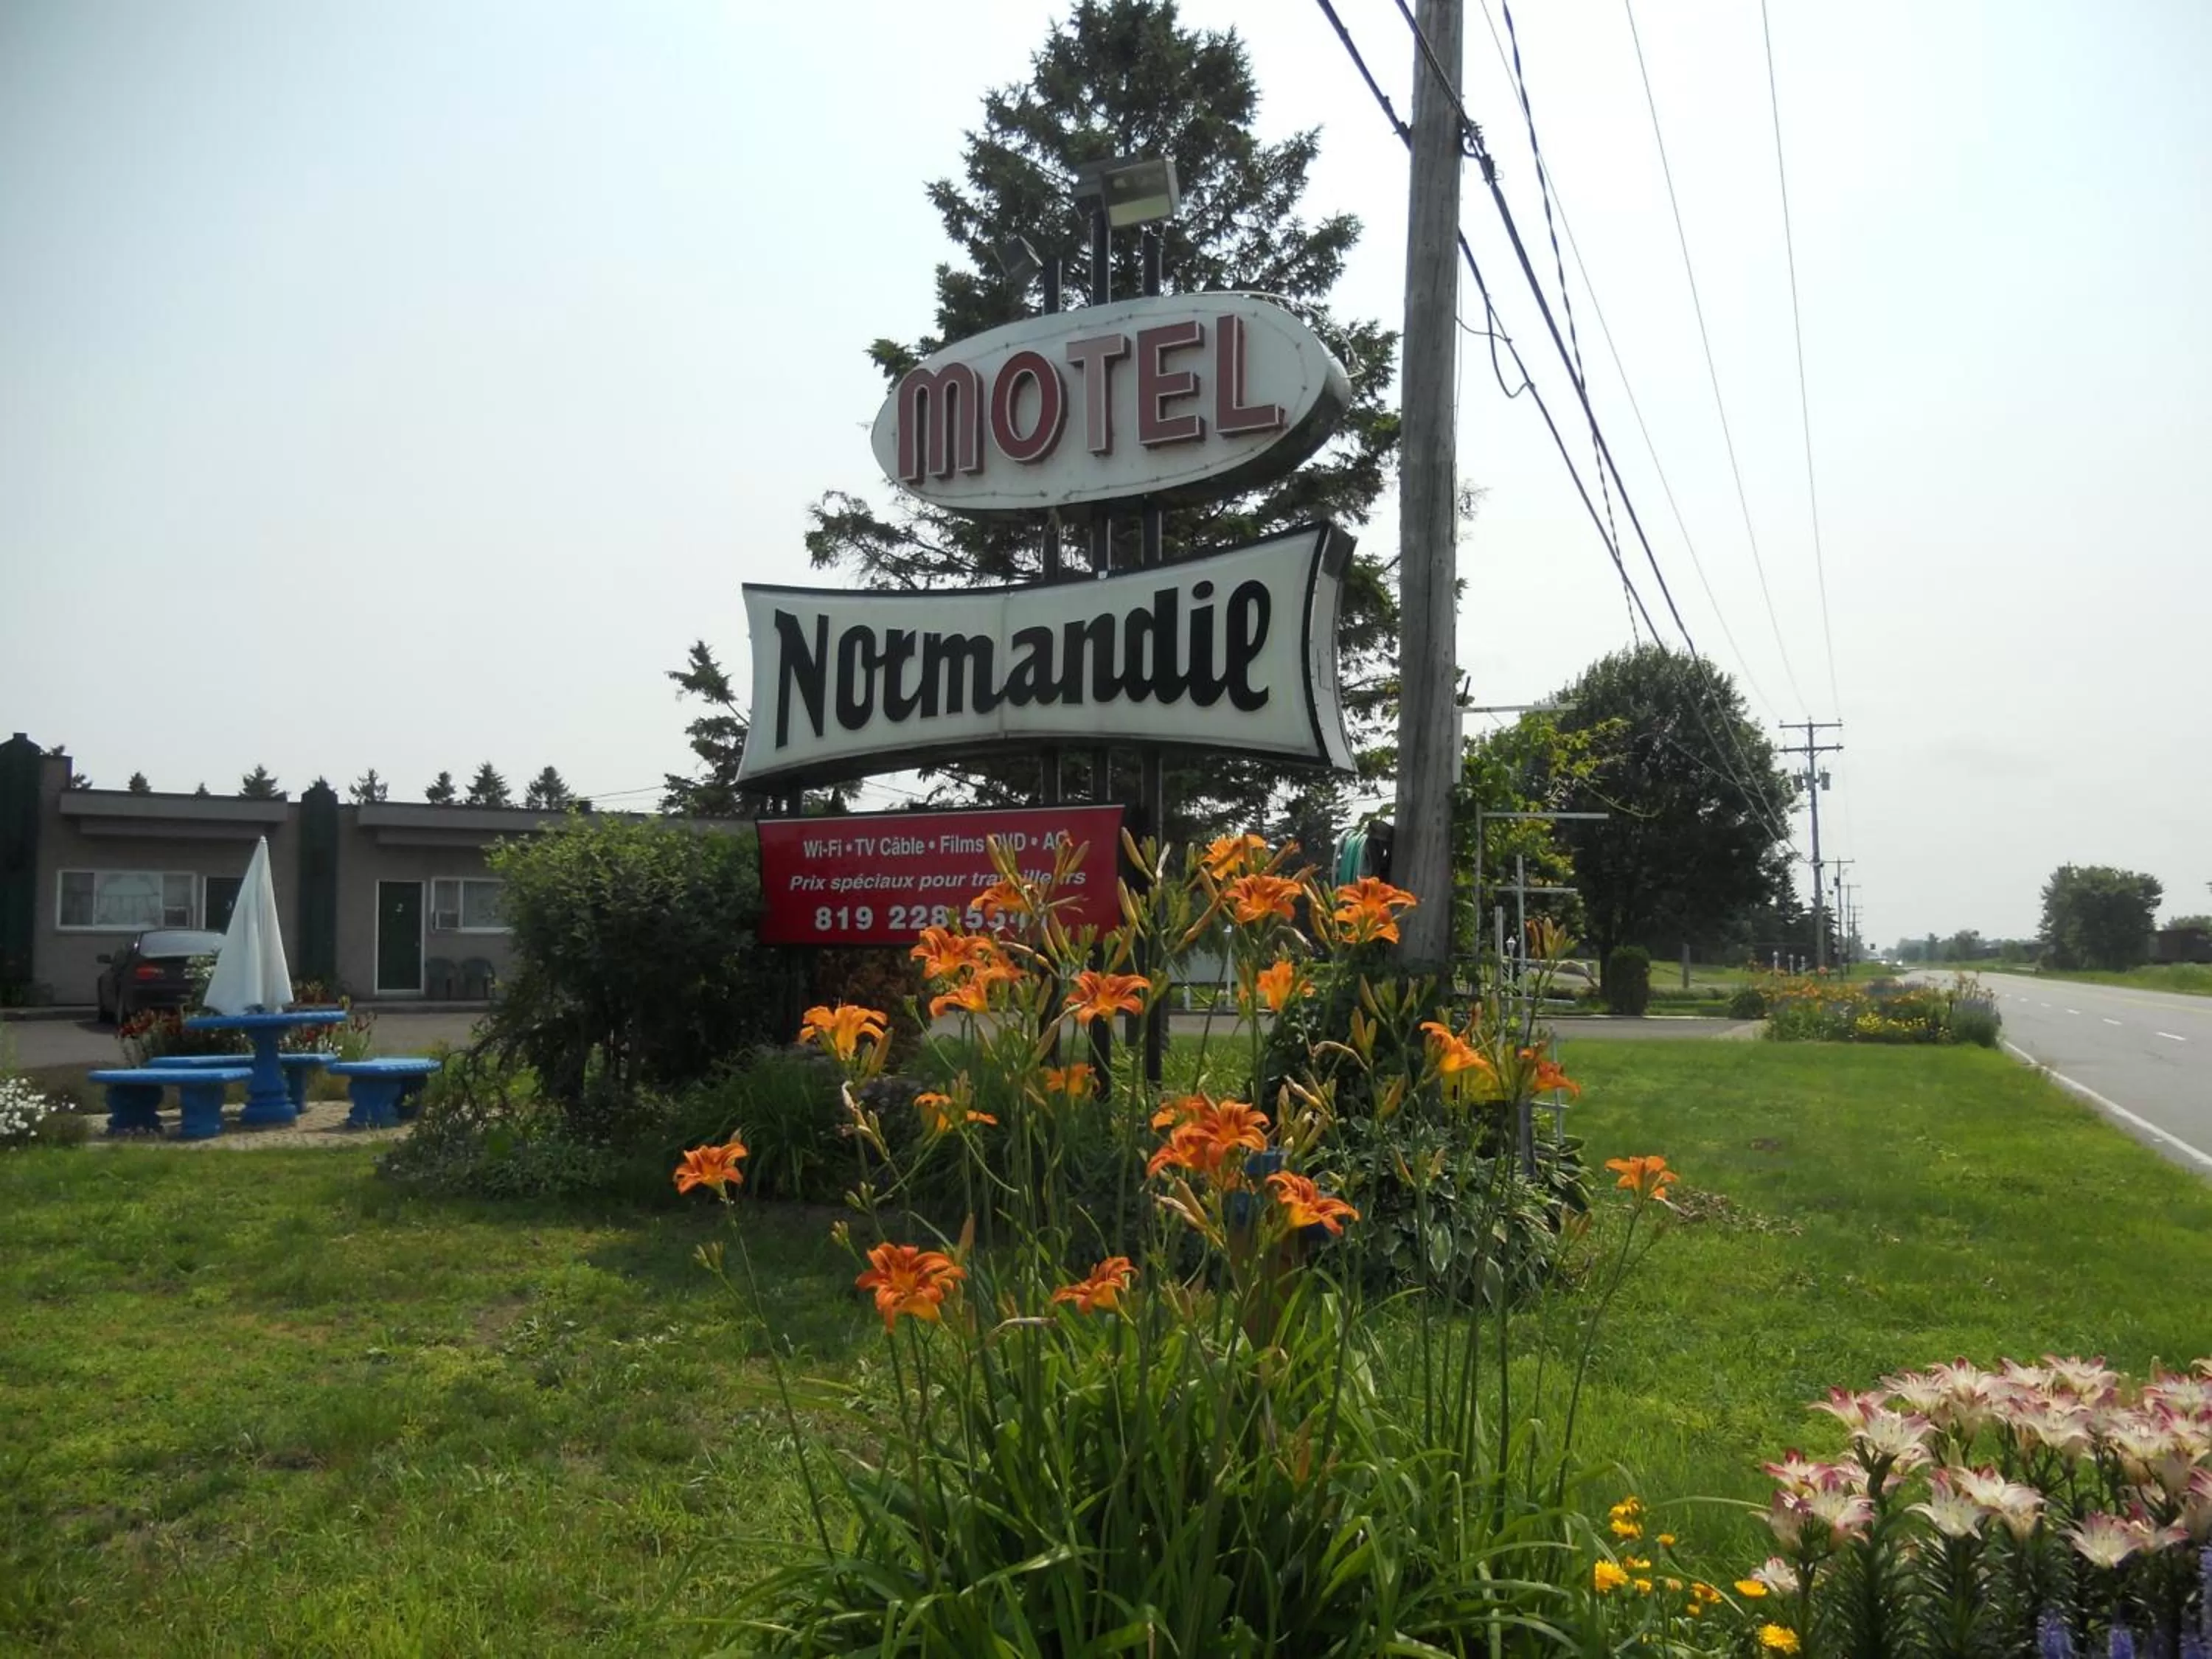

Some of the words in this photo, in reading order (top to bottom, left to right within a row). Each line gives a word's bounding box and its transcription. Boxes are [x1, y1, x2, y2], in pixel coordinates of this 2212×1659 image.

[897, 314, 1285, 485] MOTEL
[774, 580, 1272, 749] Normandie
[803, 838, 842, 858] Wi-Fi
[855, 838, 875, 856] TV
[880, 836, 925, 855] Câble
[940, 835, 985, 854] Films
[789, 874, 826, 891] Prix
[831, 873, 914, 892] spéciaux
[919, 874, 967, 891] pour
[971, 869, 1086, 887] traillers
[815, 905, 874, 931] 819
